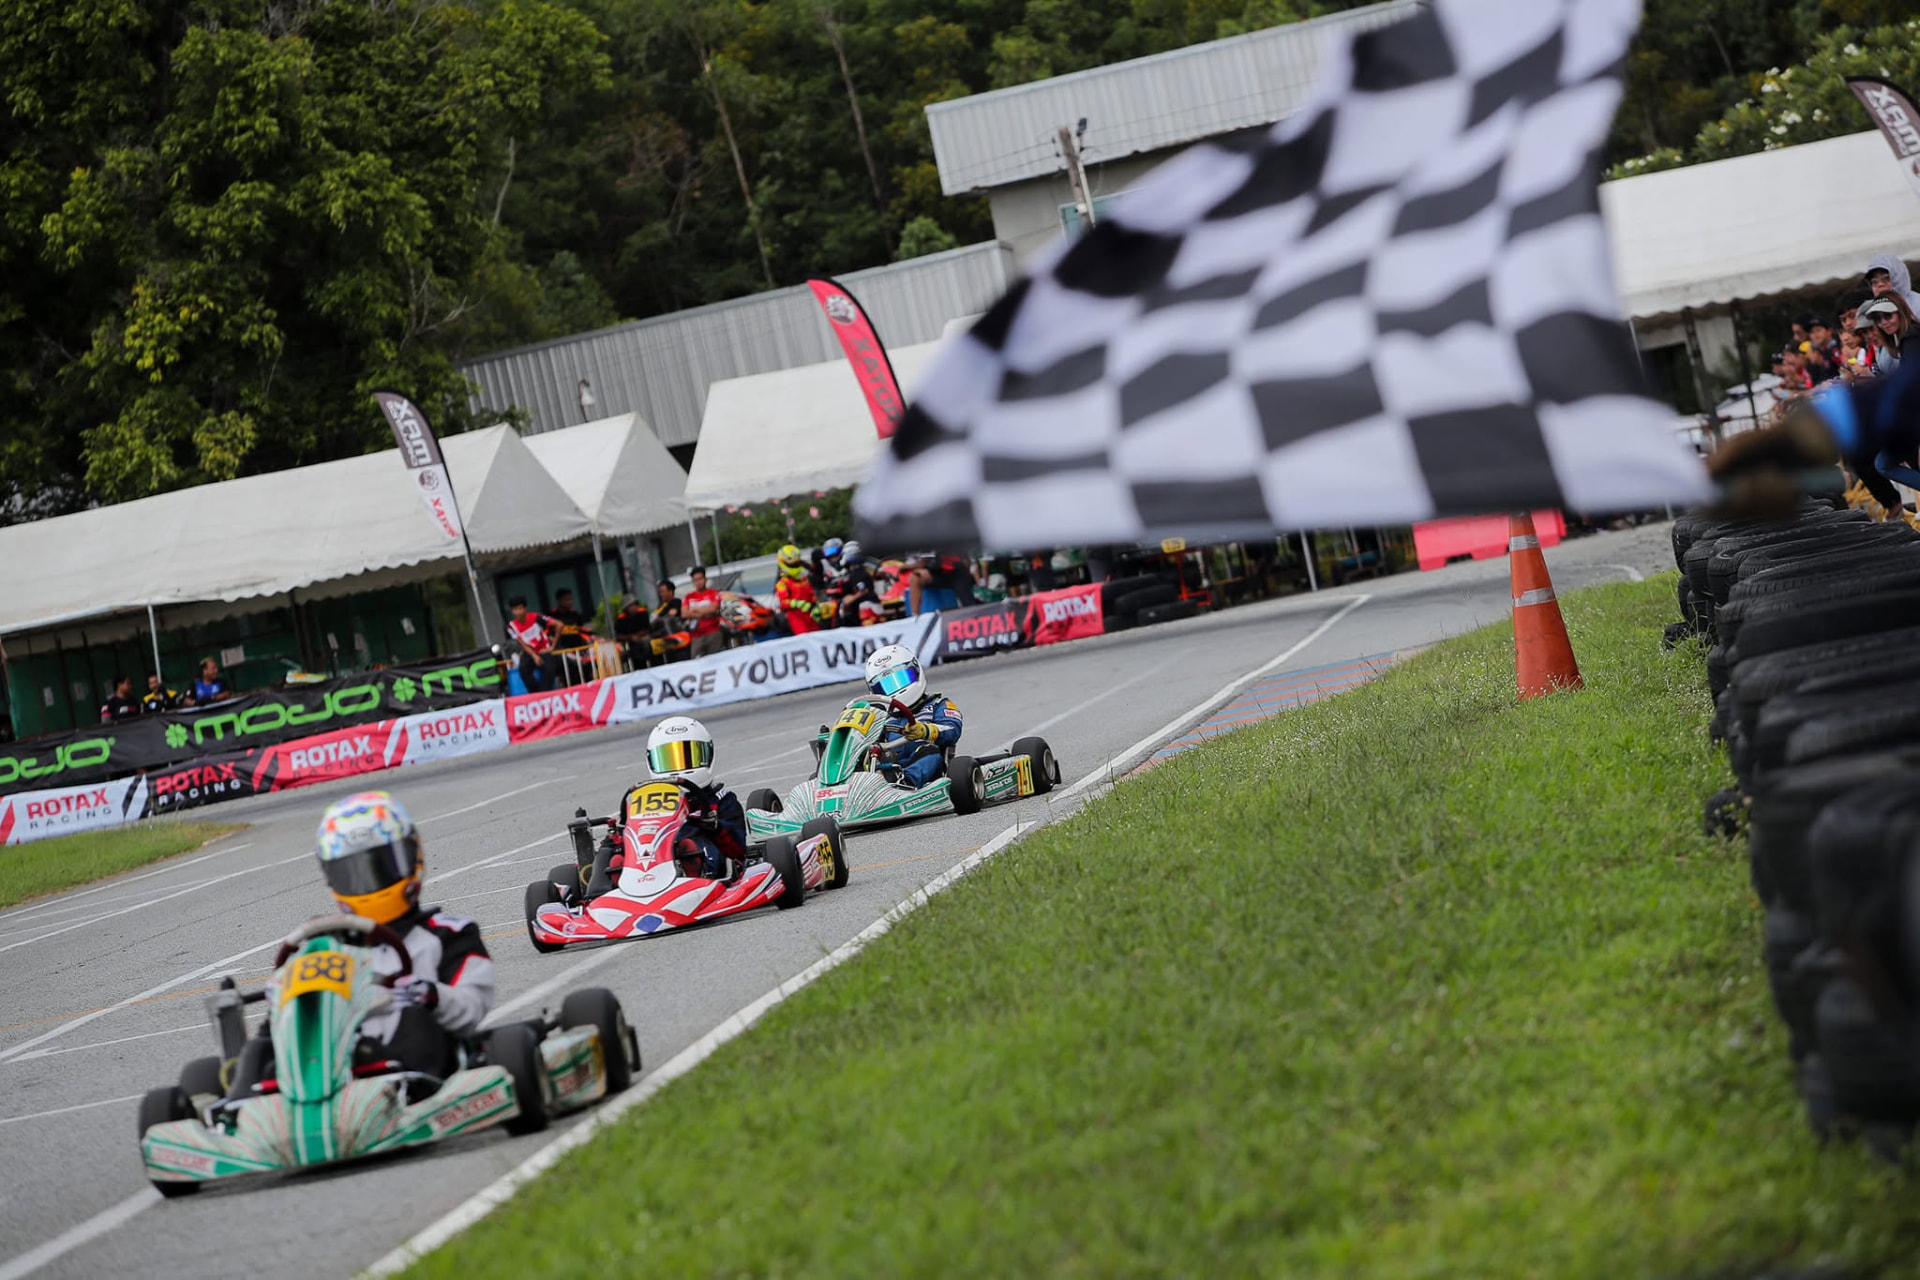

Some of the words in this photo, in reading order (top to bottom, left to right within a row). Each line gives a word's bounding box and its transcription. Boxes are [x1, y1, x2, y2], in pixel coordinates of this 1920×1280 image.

[947, 610, 1018, 641] ROTAX
[948, 631, 1019, 651] RACING
[630, 669, 716, 709] RACE
[728, 650, 810, 688] YOUR
[823, 633, 904, 669] WAY
[514, 692, 581, 725] ROTAX
[419, 709, 495, 741] ROTAX
[290, 735, 374, 771] ROTAX
[422, 730, 498, 751] RACING
[156, 761, 239, 795] ROTAX
[292, 755, 375, 779] RACING
[26, 787, 110, 820] ROTAX
[158, 779, 242, 806] RACING
[631, 792, 680, 815] 155
[905, 790, 943, 808] STRATOS
[29, 806, 112, 830] RACING
